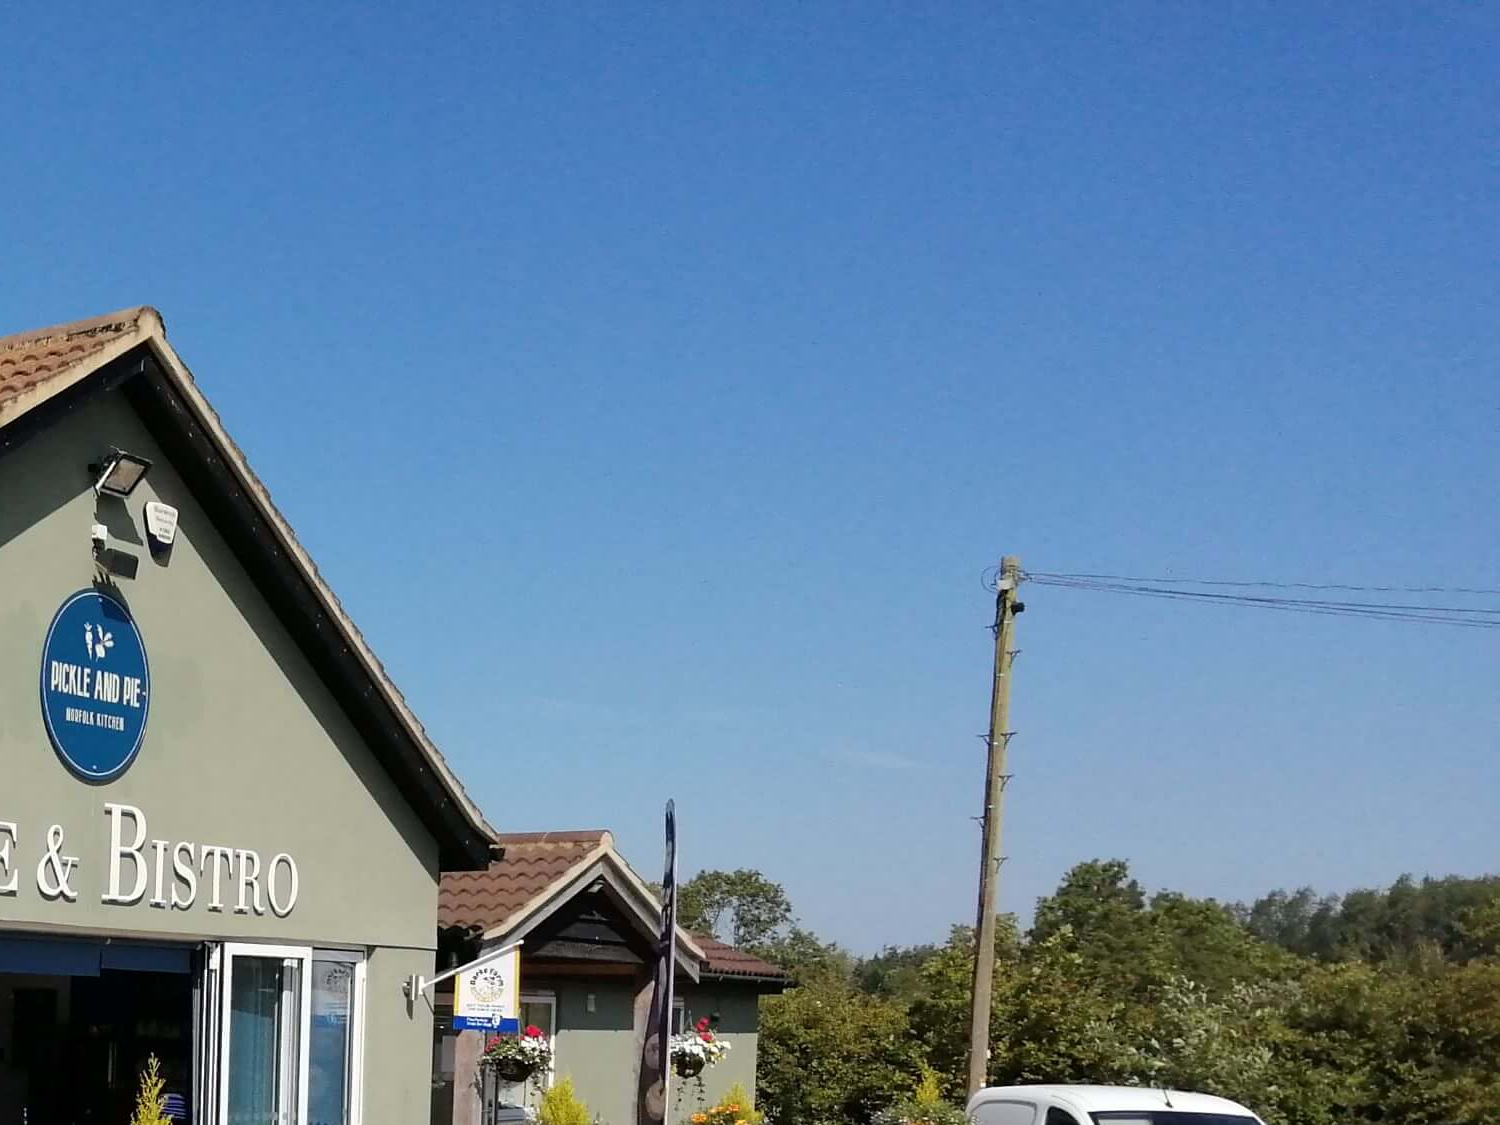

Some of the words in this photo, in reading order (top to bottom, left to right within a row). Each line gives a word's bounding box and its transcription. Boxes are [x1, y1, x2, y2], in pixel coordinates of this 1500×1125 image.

[51, 660, 91, 698] PICKLE
[94, 669, 120, 704] AND
[123, 676, 141, 708] PIE
[66, 707, 94, 726] NORFOLK
[97, 713, 124, 732] KITCHEN
[37, 824, 79, 900] &
[102, 803, 299, 918] BISTRO
